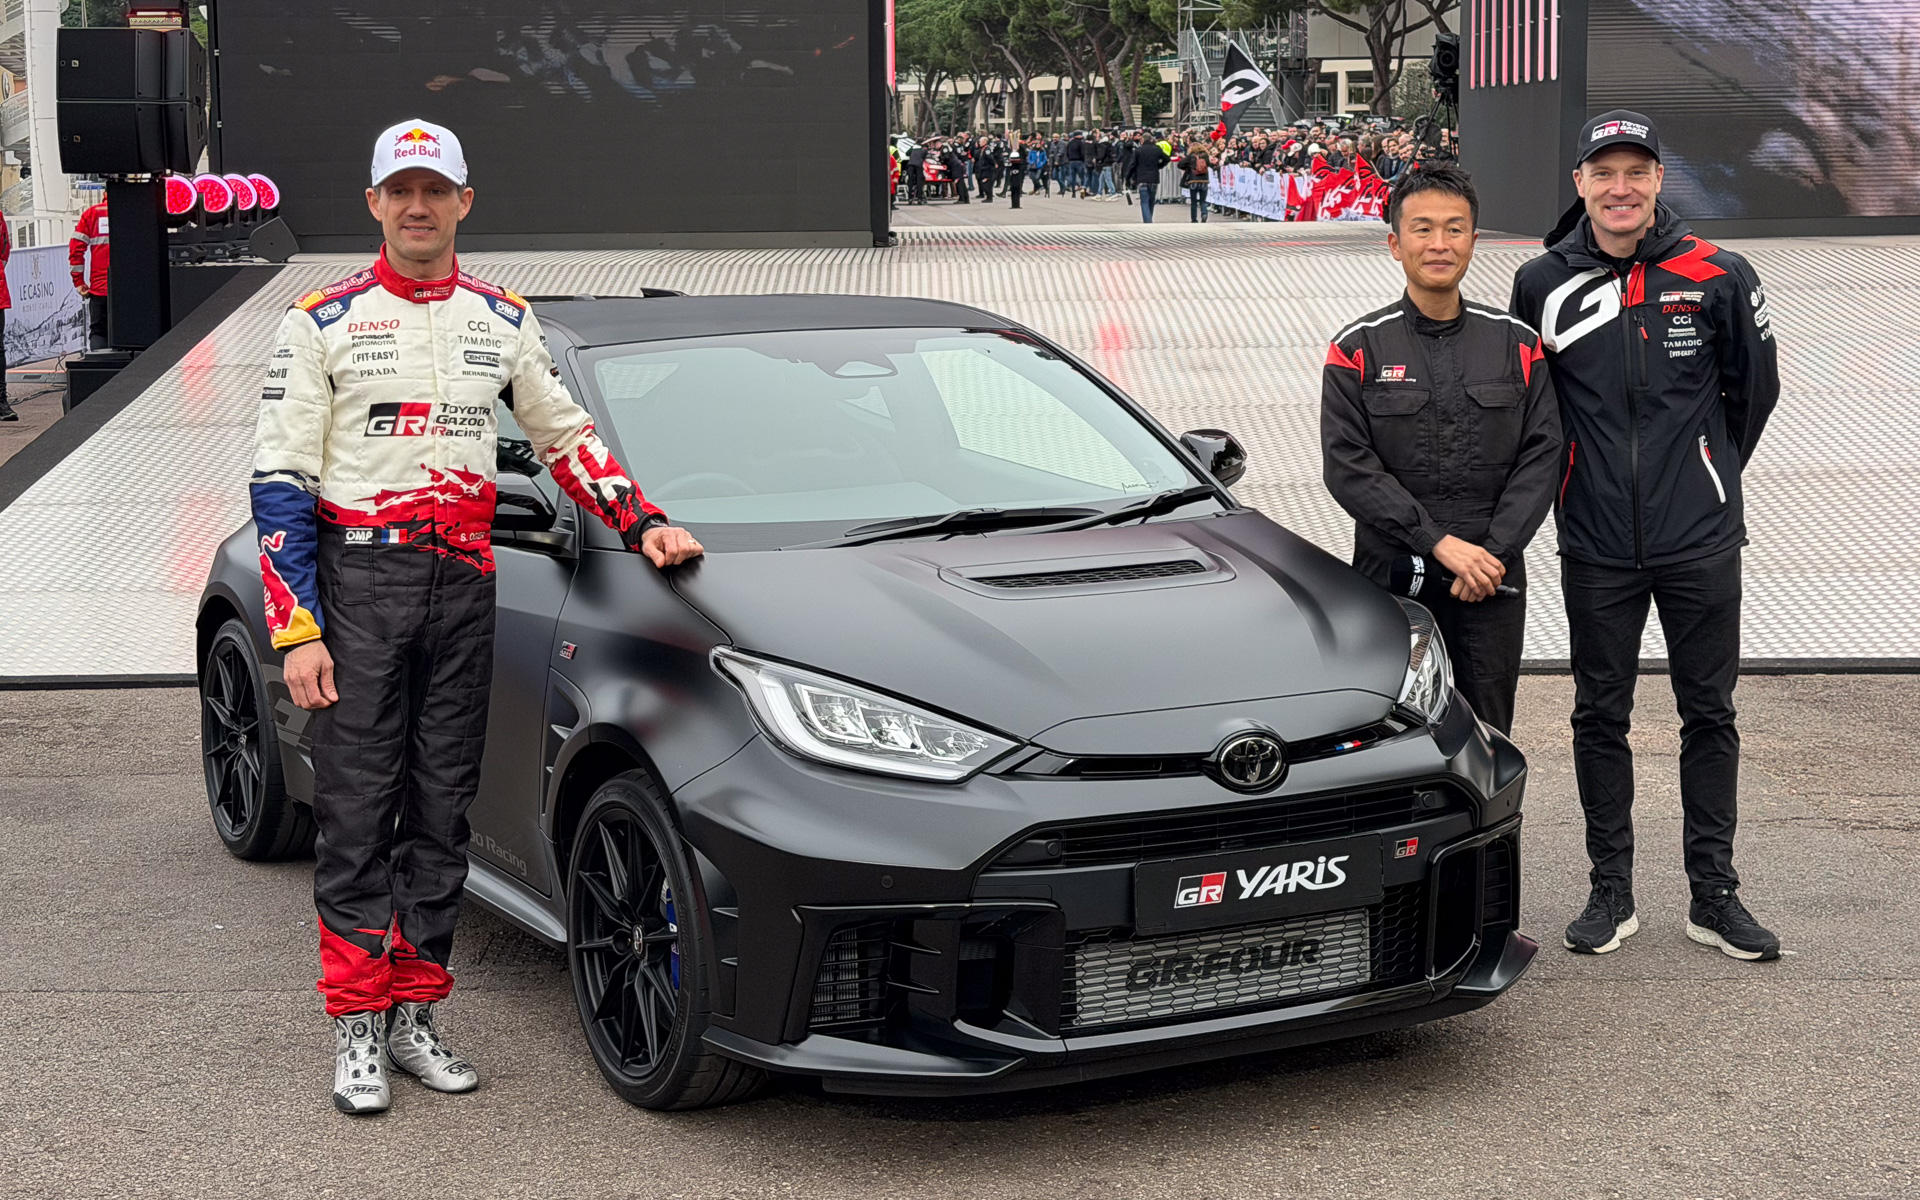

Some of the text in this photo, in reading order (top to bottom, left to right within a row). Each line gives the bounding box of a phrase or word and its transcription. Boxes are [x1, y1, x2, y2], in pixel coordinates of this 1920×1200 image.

[394, 144, 441, 159] Red Bull
[19, 281, 55, 301] LE CASINO
[317, 304, 344, 319] OMP
[495, 303, 520, 318] OMP
[1662, 304, 1701, 314] DENSO
[347, 319, 400, 333] DENSO
[351, 332, 395, 341] Panasonic
[458, 335, 502, 349] TAMADIC
[351, 340, 398, 348] AUTOMOTIVE
[1663, 339, 1703, 348] TAMADIC
[359, 367, 398, 378] PRADA
[462, 370, 488, 379] RICHARD
[438, 403, 492, 416] TOYOTA
[436, 415, 486, 427] GAZOO
[431, 426, 483, 440] Racing
[345, 530, 374, 542] OMP
[485, 835, 527, 877] Racing
